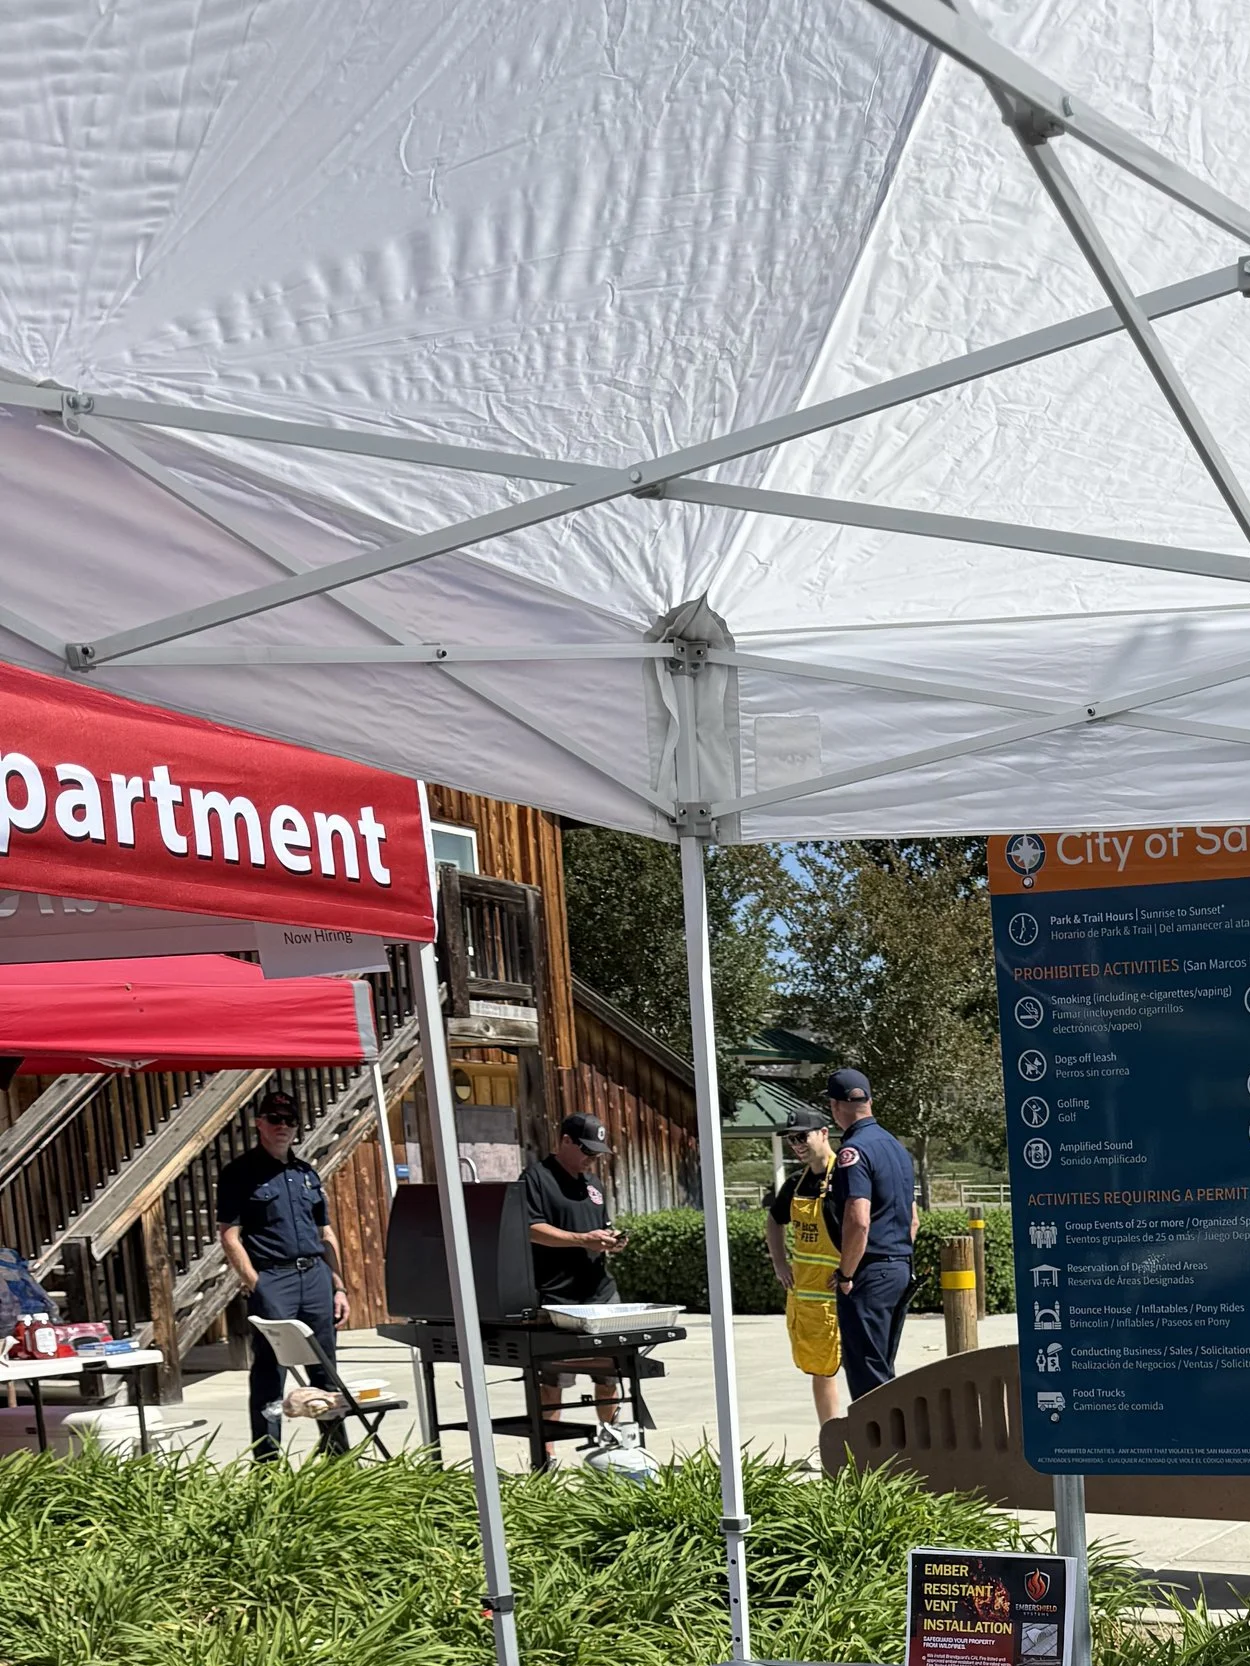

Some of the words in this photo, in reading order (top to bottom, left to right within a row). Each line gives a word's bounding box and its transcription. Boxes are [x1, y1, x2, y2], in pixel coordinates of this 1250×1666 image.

[1057, 832, 1134, 871] City
[1144, 826, 1183, 859] of
[1050, 914, 1071, 926] Park
[1073, 914, 1080, 924] &
[1082, 912, 1103, 924] Trail
[1105, 911, 1133, 922] Hours
[1140, 908, 1175, 920] Sunrise
[1177, 908, 1187, 918] to
[1051, 929, 1085, 940] Horario
[1087, 928, 1099, 938] de
[1100, 926, 1121, 937] Park
[1123, 926, 1130, 936] &
[1133, 924, 1152, 935] Trail
[1159, 923, 1174, 933] Del
[1176, 923, 1222, 932] amanecer
[1224, 919, 1233, 929] al
[283, 931, 312, 945] Now
[315, 929, 353, 944] Hiring
[1014, 964, 1100, 981] PROHIBITED
[1103, 960, 1179, 976] ACTIVITIES
[1183, 957, 1206, 973] (San
[1209, 956, 1246, 969] Marcos
[1051, 993, 1091, 1007] Smoking
[1093, 991, 1139, 1005] (including
[1140, 987, 1232, 1003] e-cigarettes/vaping)
[1052, 1010, 1080, 1020] Fumar
[1083, 1006, 1136, 1020] (incluyendo
[1138, 1004, 1183, 1017] cigarrillos
[1052, 1021, 1142, 1035] electrónicos/vapeo)
[1054, 1054, 1077, 1067] Dogs
[1078, 1053, 1090, 1063] off
[1092, 1052, 1116, 1063] leash
[1055, 1068, 1084, 1079] Perros
[1085, 1067, 1099, 1077] sin
[1100, 1069, 1129, 1077] correa
[1057, 1098, 1089, 1110] Golfing
[1058, 1112, 1076, 1122] Golf
[1059, 1141, 1102, 1154] Amplified
[1103, 1140, 1133, 1150] Sound
[1060, 1155, 1092, 1166] Sonido
[1093, 1154, 1147, 1167] Amplificado
[1028, 1191, 1100, 1206] ACTIVITIES
[1104, 1189, 1181, 1206] REQUIRING
[1184, 1188, 1193, 1202] A
[1197, 1187, 1249, 1202] PERMIT
[1064, 1219, 1092, 1233] Group
[1094, 1218, 1124, 1229] Events
[1124, 1217, 1134, 1229] of
[1136, 1218, 1147, 1228] 25
[1148, 1220, 1158, 1228] or
[1160, 1219, 1184, 1228] more
[1191, 1215, 1238, 1229] Organized
[801, 1233, 819, 1242] FEET
[1066, 1261, 1118, 1272] Reservation
[1120, 1261, 1129, 1271] of
[1182, 1260, 1208, 1270] Areas
[1069, 1304, 1102, 1314] Bounce
[1103, 1304, 1132, 1314] House
[1141, 1302, 1188, 1313] Inflatables
[1195, 1302, 1218, 1315] Pony
[1219, 1301, 1244, 1312] Rides
[1070, 1346, 1121, 1359] Conducting
[1122, 1345, 1162, 1356] Business
[1169, 1345, 1192, 1355] Sales
[1200, 1344, 1250, 1355] Solicitation
[1072, 1387, 1094, 1397] Food
[1096, 1387, 1125, 1397] Trucks
[925, 1564, 968, 1577] EMBER
[924, 1583, 993, 1597] RESISTANT
[924, 1600, 958, 1612] VENT
[1016, 1604, 1057, 1612] EMBERSHIELD
[923, 1619, 1012, 1634] INSTALLATION
